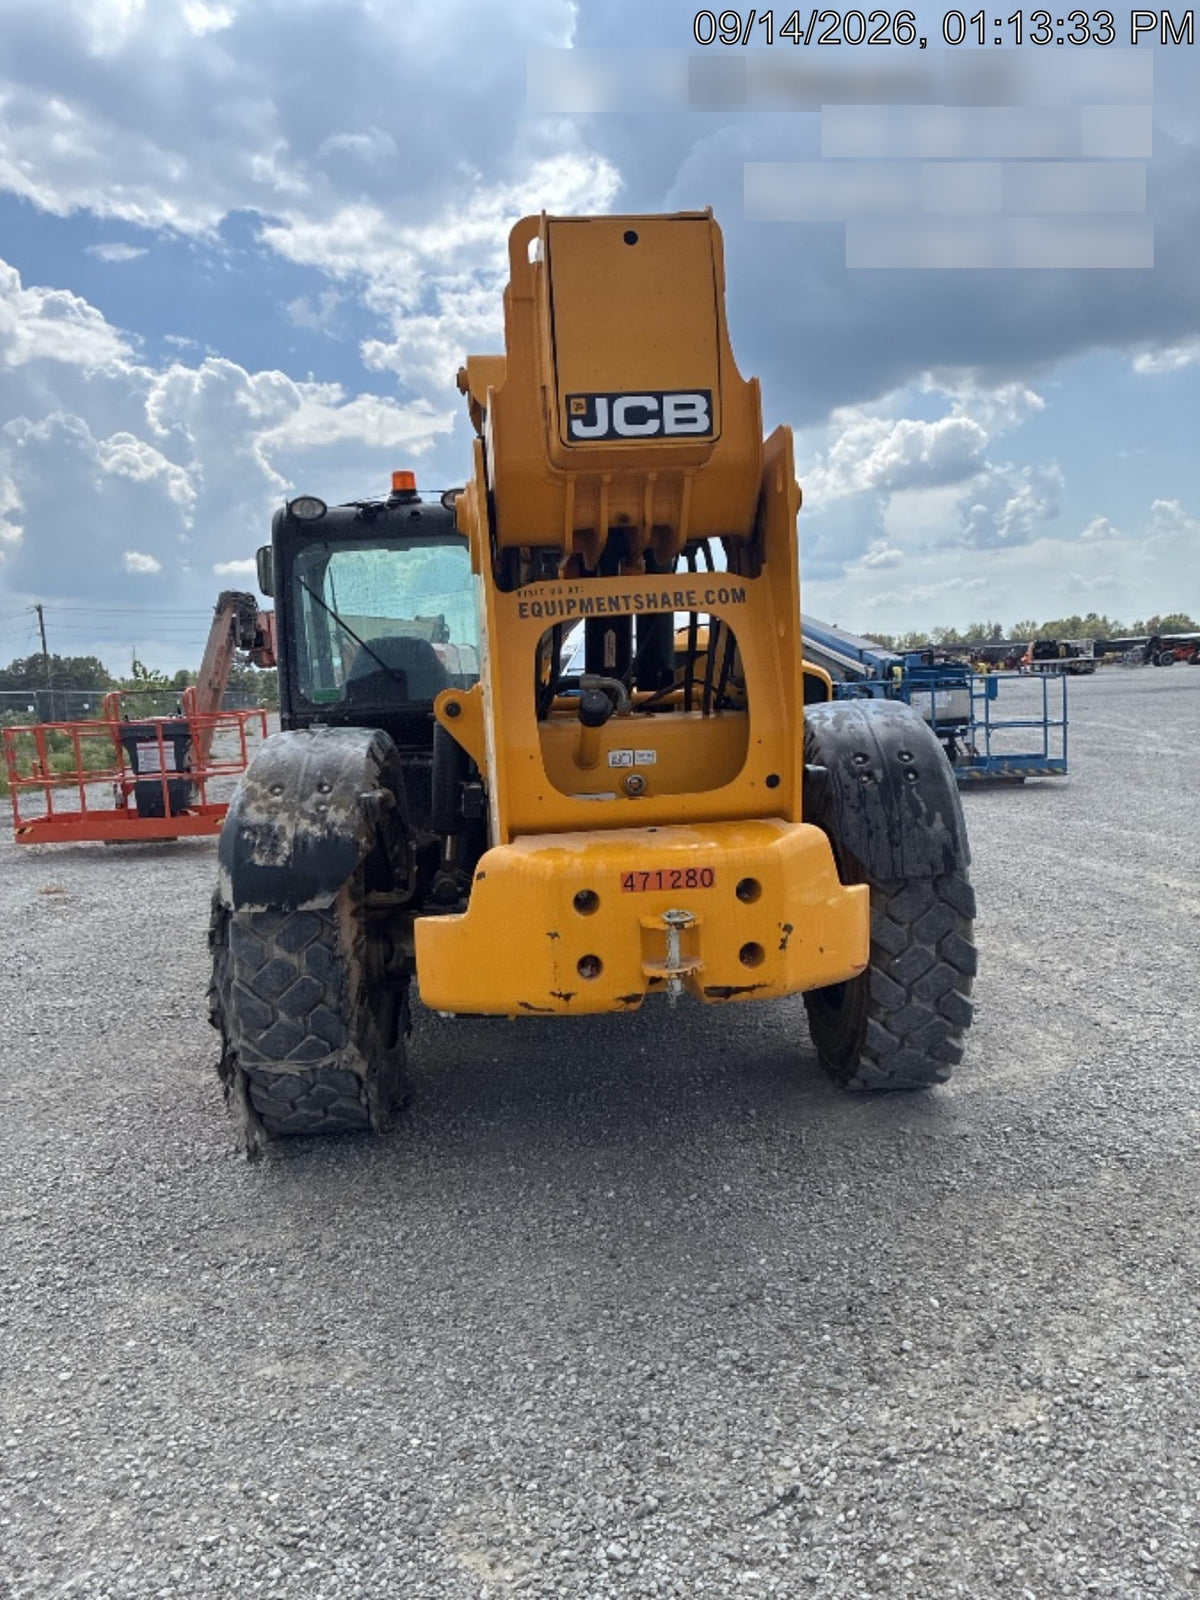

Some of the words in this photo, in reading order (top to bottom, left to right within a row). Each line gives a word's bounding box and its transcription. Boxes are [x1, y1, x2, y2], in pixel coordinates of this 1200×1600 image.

[571, 393, 710, 438] JCB
[518, 587, 747, 619] EQUIPMENTSHARE.COM
[623, 868, 714, 892] 471280
